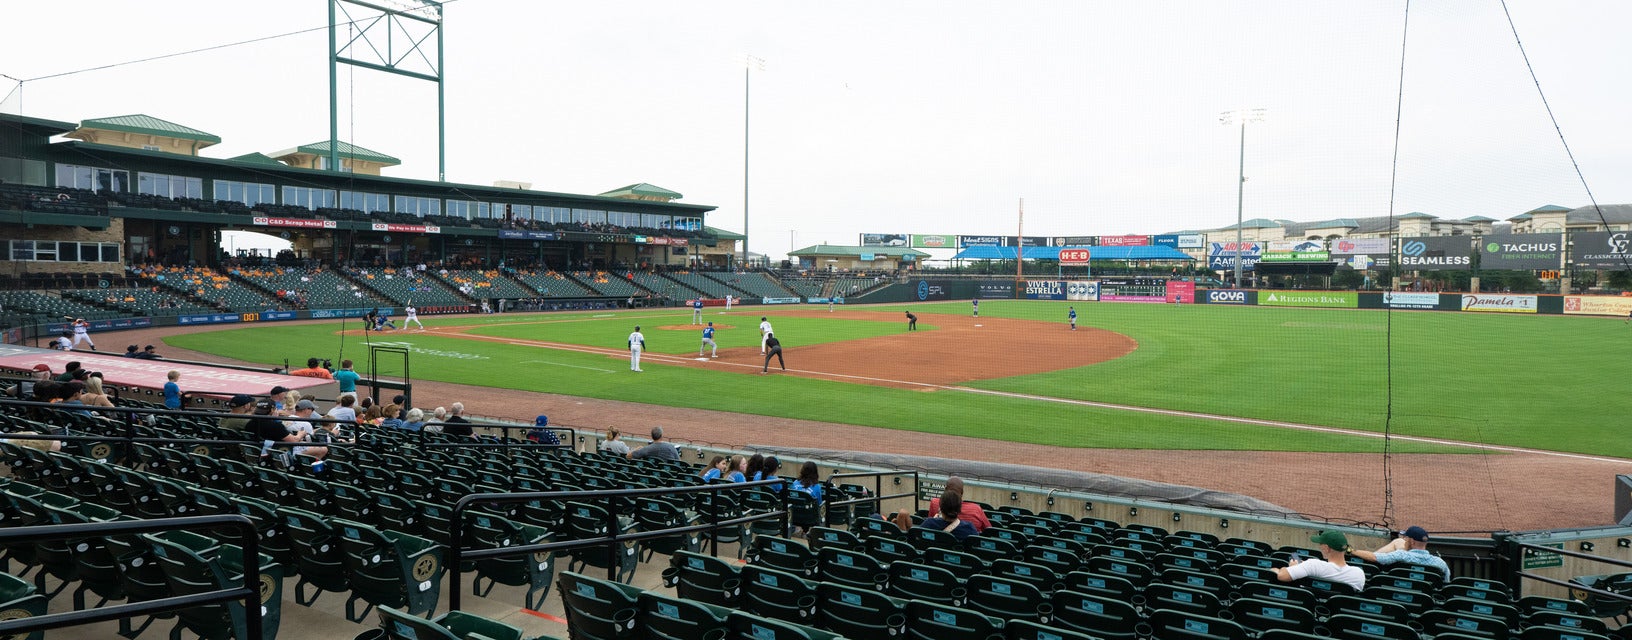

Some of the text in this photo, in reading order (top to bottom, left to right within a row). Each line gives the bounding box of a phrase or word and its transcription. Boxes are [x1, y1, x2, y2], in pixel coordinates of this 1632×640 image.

[1223, 242, 1254, 251] AROW
[1503, 243, 1557, 252] TACHUS
[1402, 256, 1470, 265] SEAMLESS
[929, 286, 945, 295] SPL
[1026, 287, 1062, 295] ESTRELLA
[1210, 291, 1245, 302] GOYA
[1463, 295, 1514, 310] Pamela
